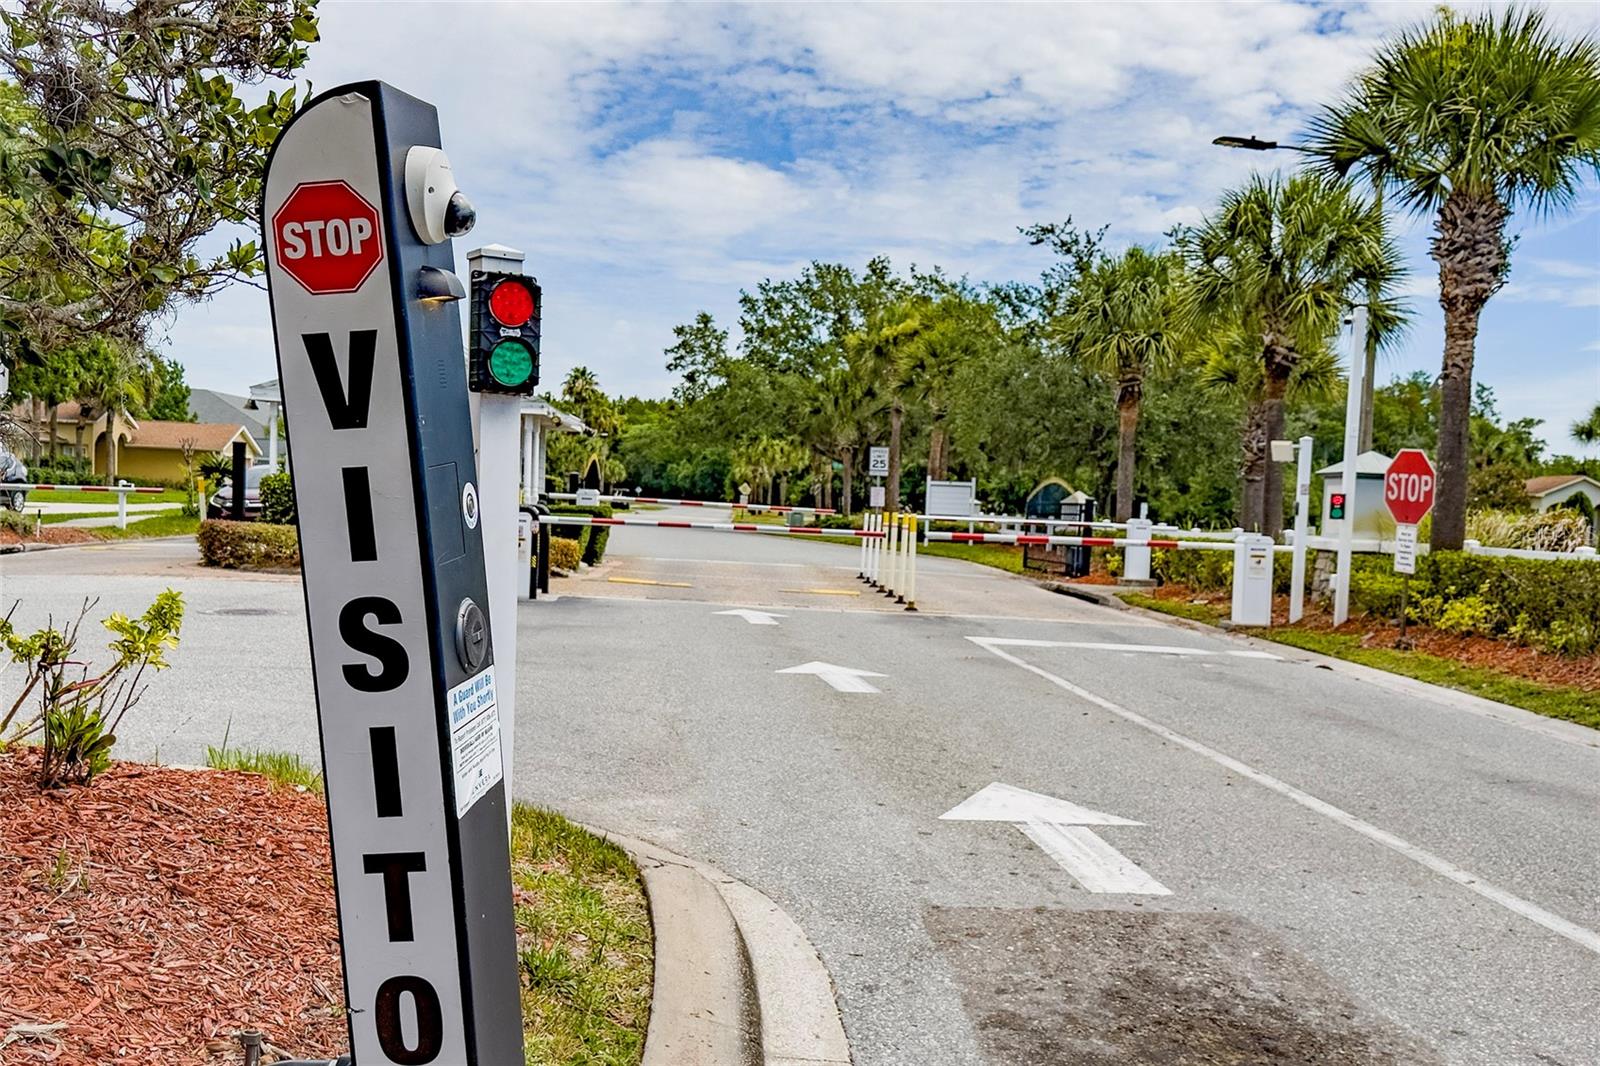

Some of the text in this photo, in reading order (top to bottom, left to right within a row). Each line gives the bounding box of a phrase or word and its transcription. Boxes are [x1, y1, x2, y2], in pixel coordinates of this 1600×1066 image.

[282, 217, 373, 260] STOP
[872, 459, 887, 468] 25
[1387, 472, 1433, 503] STOP
[453, 674, 492, 706] A Guard Will Be
[453, 706, 466, 724] With
[466, 701, 477, 714] You
[477, 688, 494, 708] Shortly
